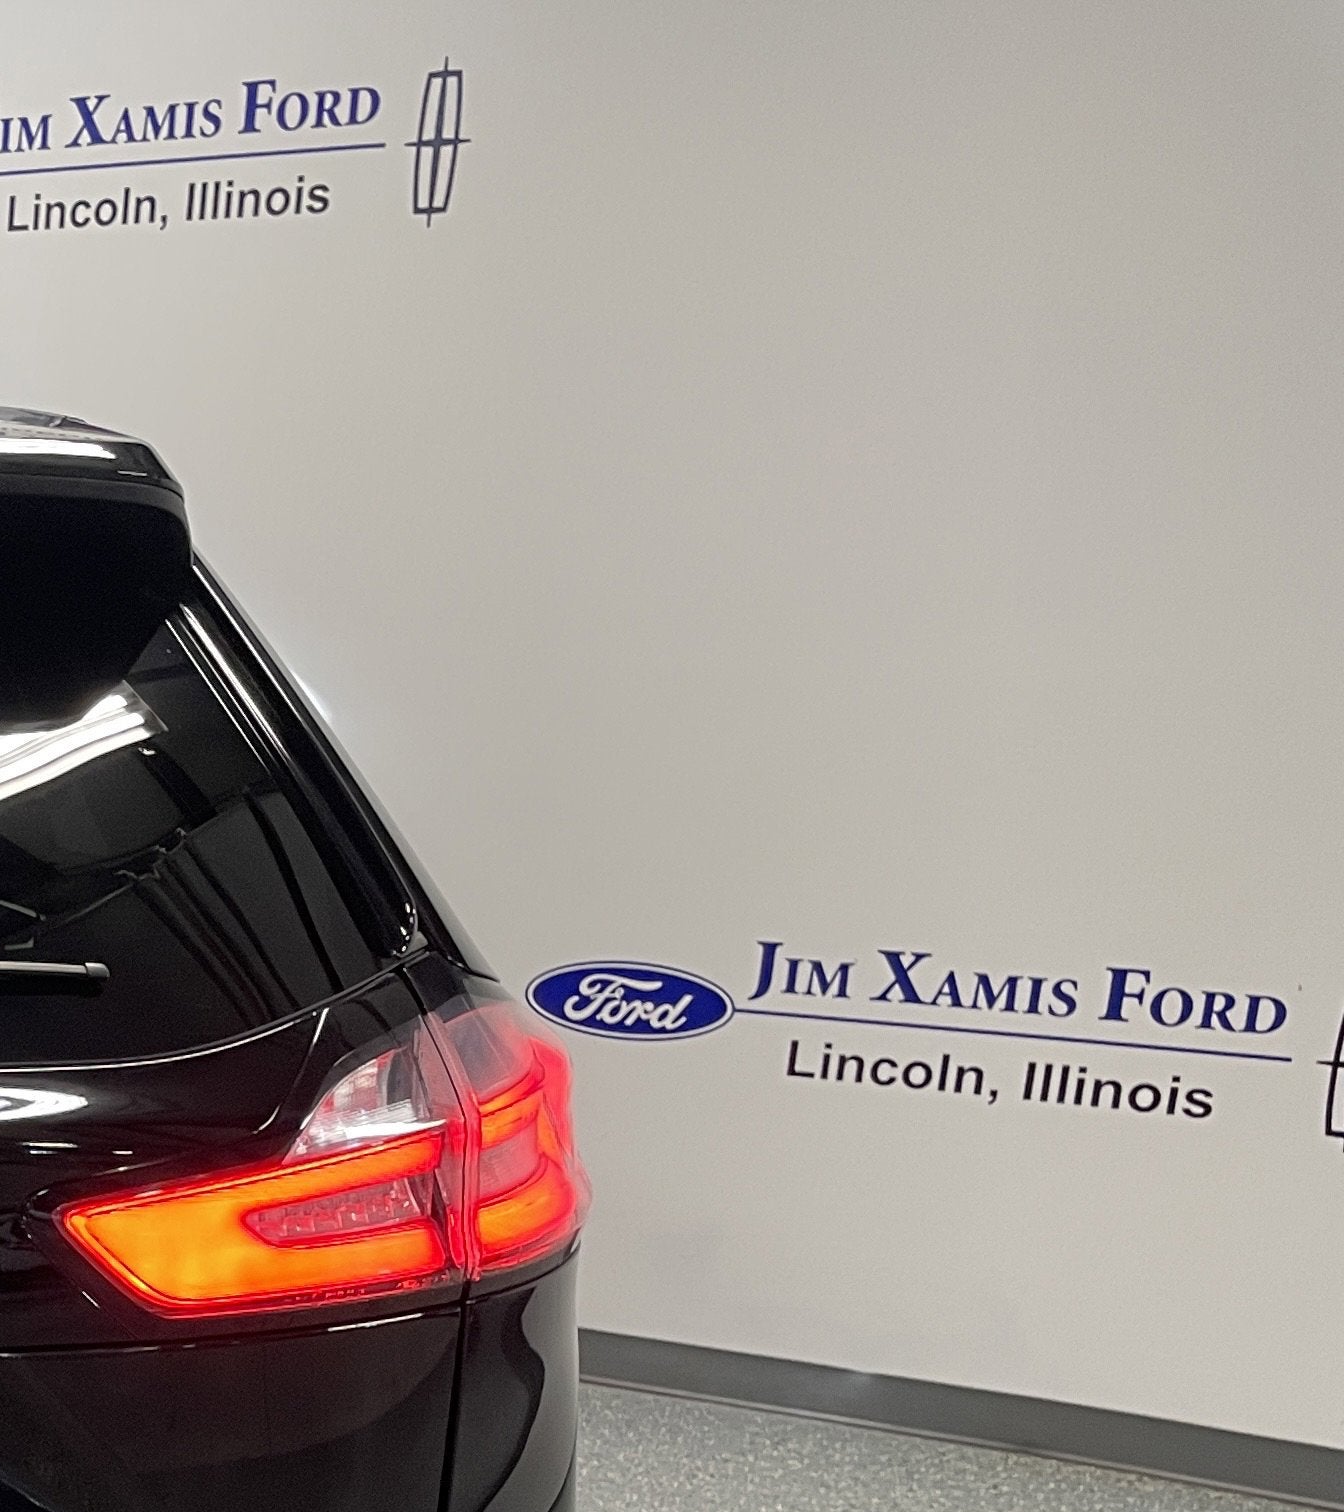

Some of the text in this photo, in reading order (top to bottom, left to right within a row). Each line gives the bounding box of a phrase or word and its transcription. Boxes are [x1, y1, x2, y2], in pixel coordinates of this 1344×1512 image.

[64, 94, 222, 149] XAMIS
[237, 78, 381, 135] FORD
[7, 175, 330, 232] Lincoln, Illinois
[564, 972, 694, 1033] Ford
[747, 941, 1288, 1034] JIM XAMIS FORD
[786, 1039, 1213, 1119] Lincoln, Illinois
